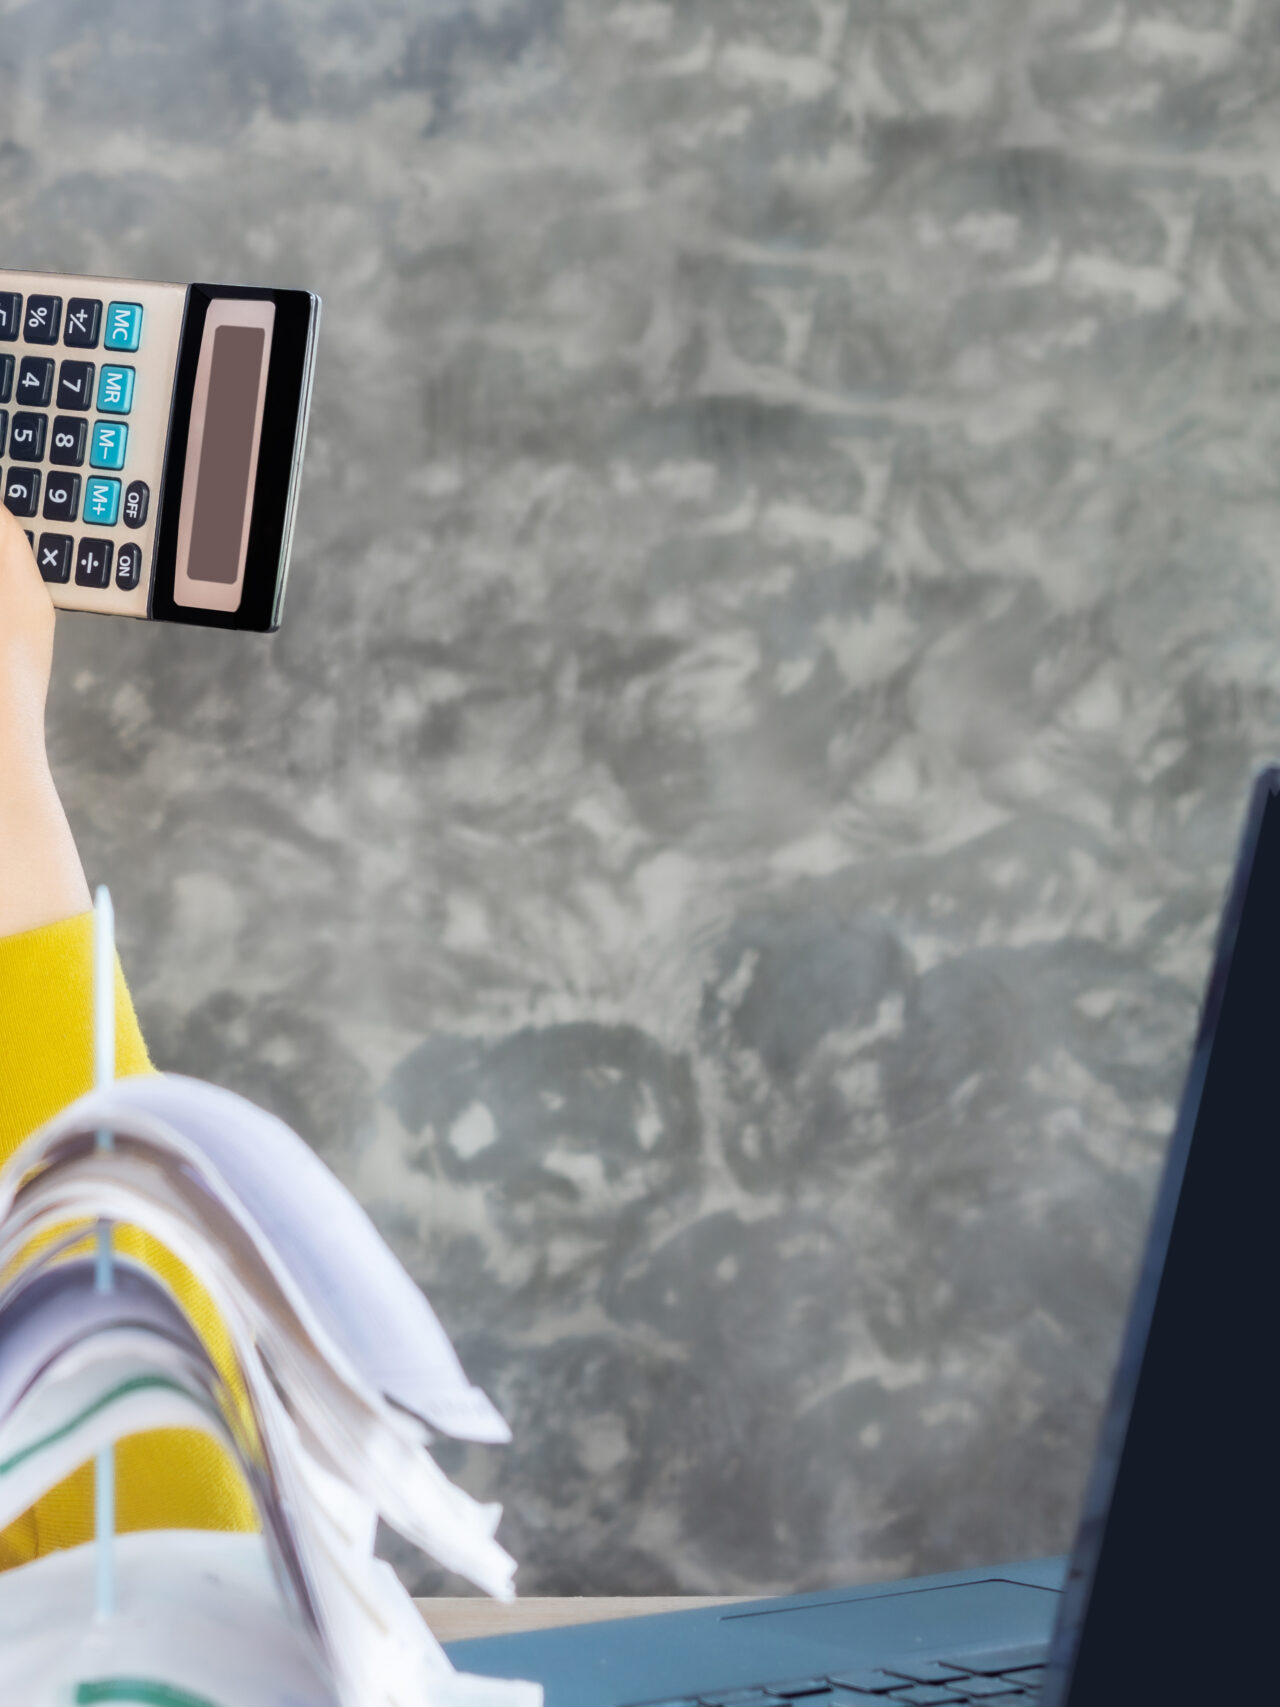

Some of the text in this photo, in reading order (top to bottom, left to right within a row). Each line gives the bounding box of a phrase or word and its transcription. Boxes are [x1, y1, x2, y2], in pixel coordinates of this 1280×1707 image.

[112, 309, 127, 340] MC
[22, 373, 39, 387] 4
[63, 379, 81, 392] 7
[104, 372, 122, 404] MR
[15, 429, 32, 441] 5
[56, 433, 74, 447] 8
[98, 429, 115, 460] M-
[8, 485, 27, 498] 6
[49, 489, 67, 503] 9
[92, 485, 110, 516] M+
[125, 491, 139, 519] OFF
[118, 556, 130, 577] ON
